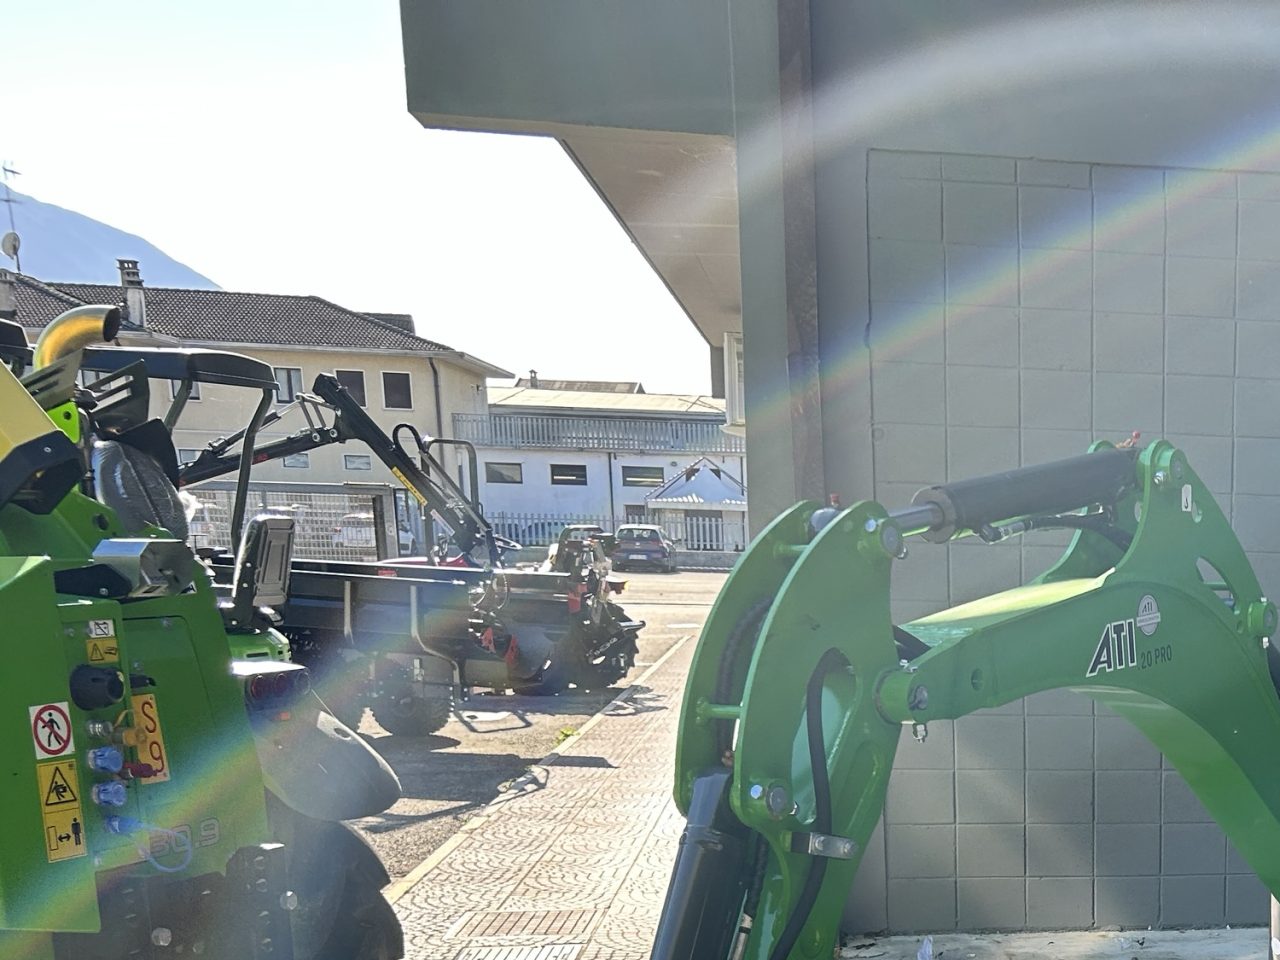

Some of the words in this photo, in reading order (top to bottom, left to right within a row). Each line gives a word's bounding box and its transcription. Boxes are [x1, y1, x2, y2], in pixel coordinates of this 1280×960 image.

[1142, 601, 1153, 613] ATI
[1085, 618, 1137, 677] ATI
[1154, 644, 1172, 665] PRO
